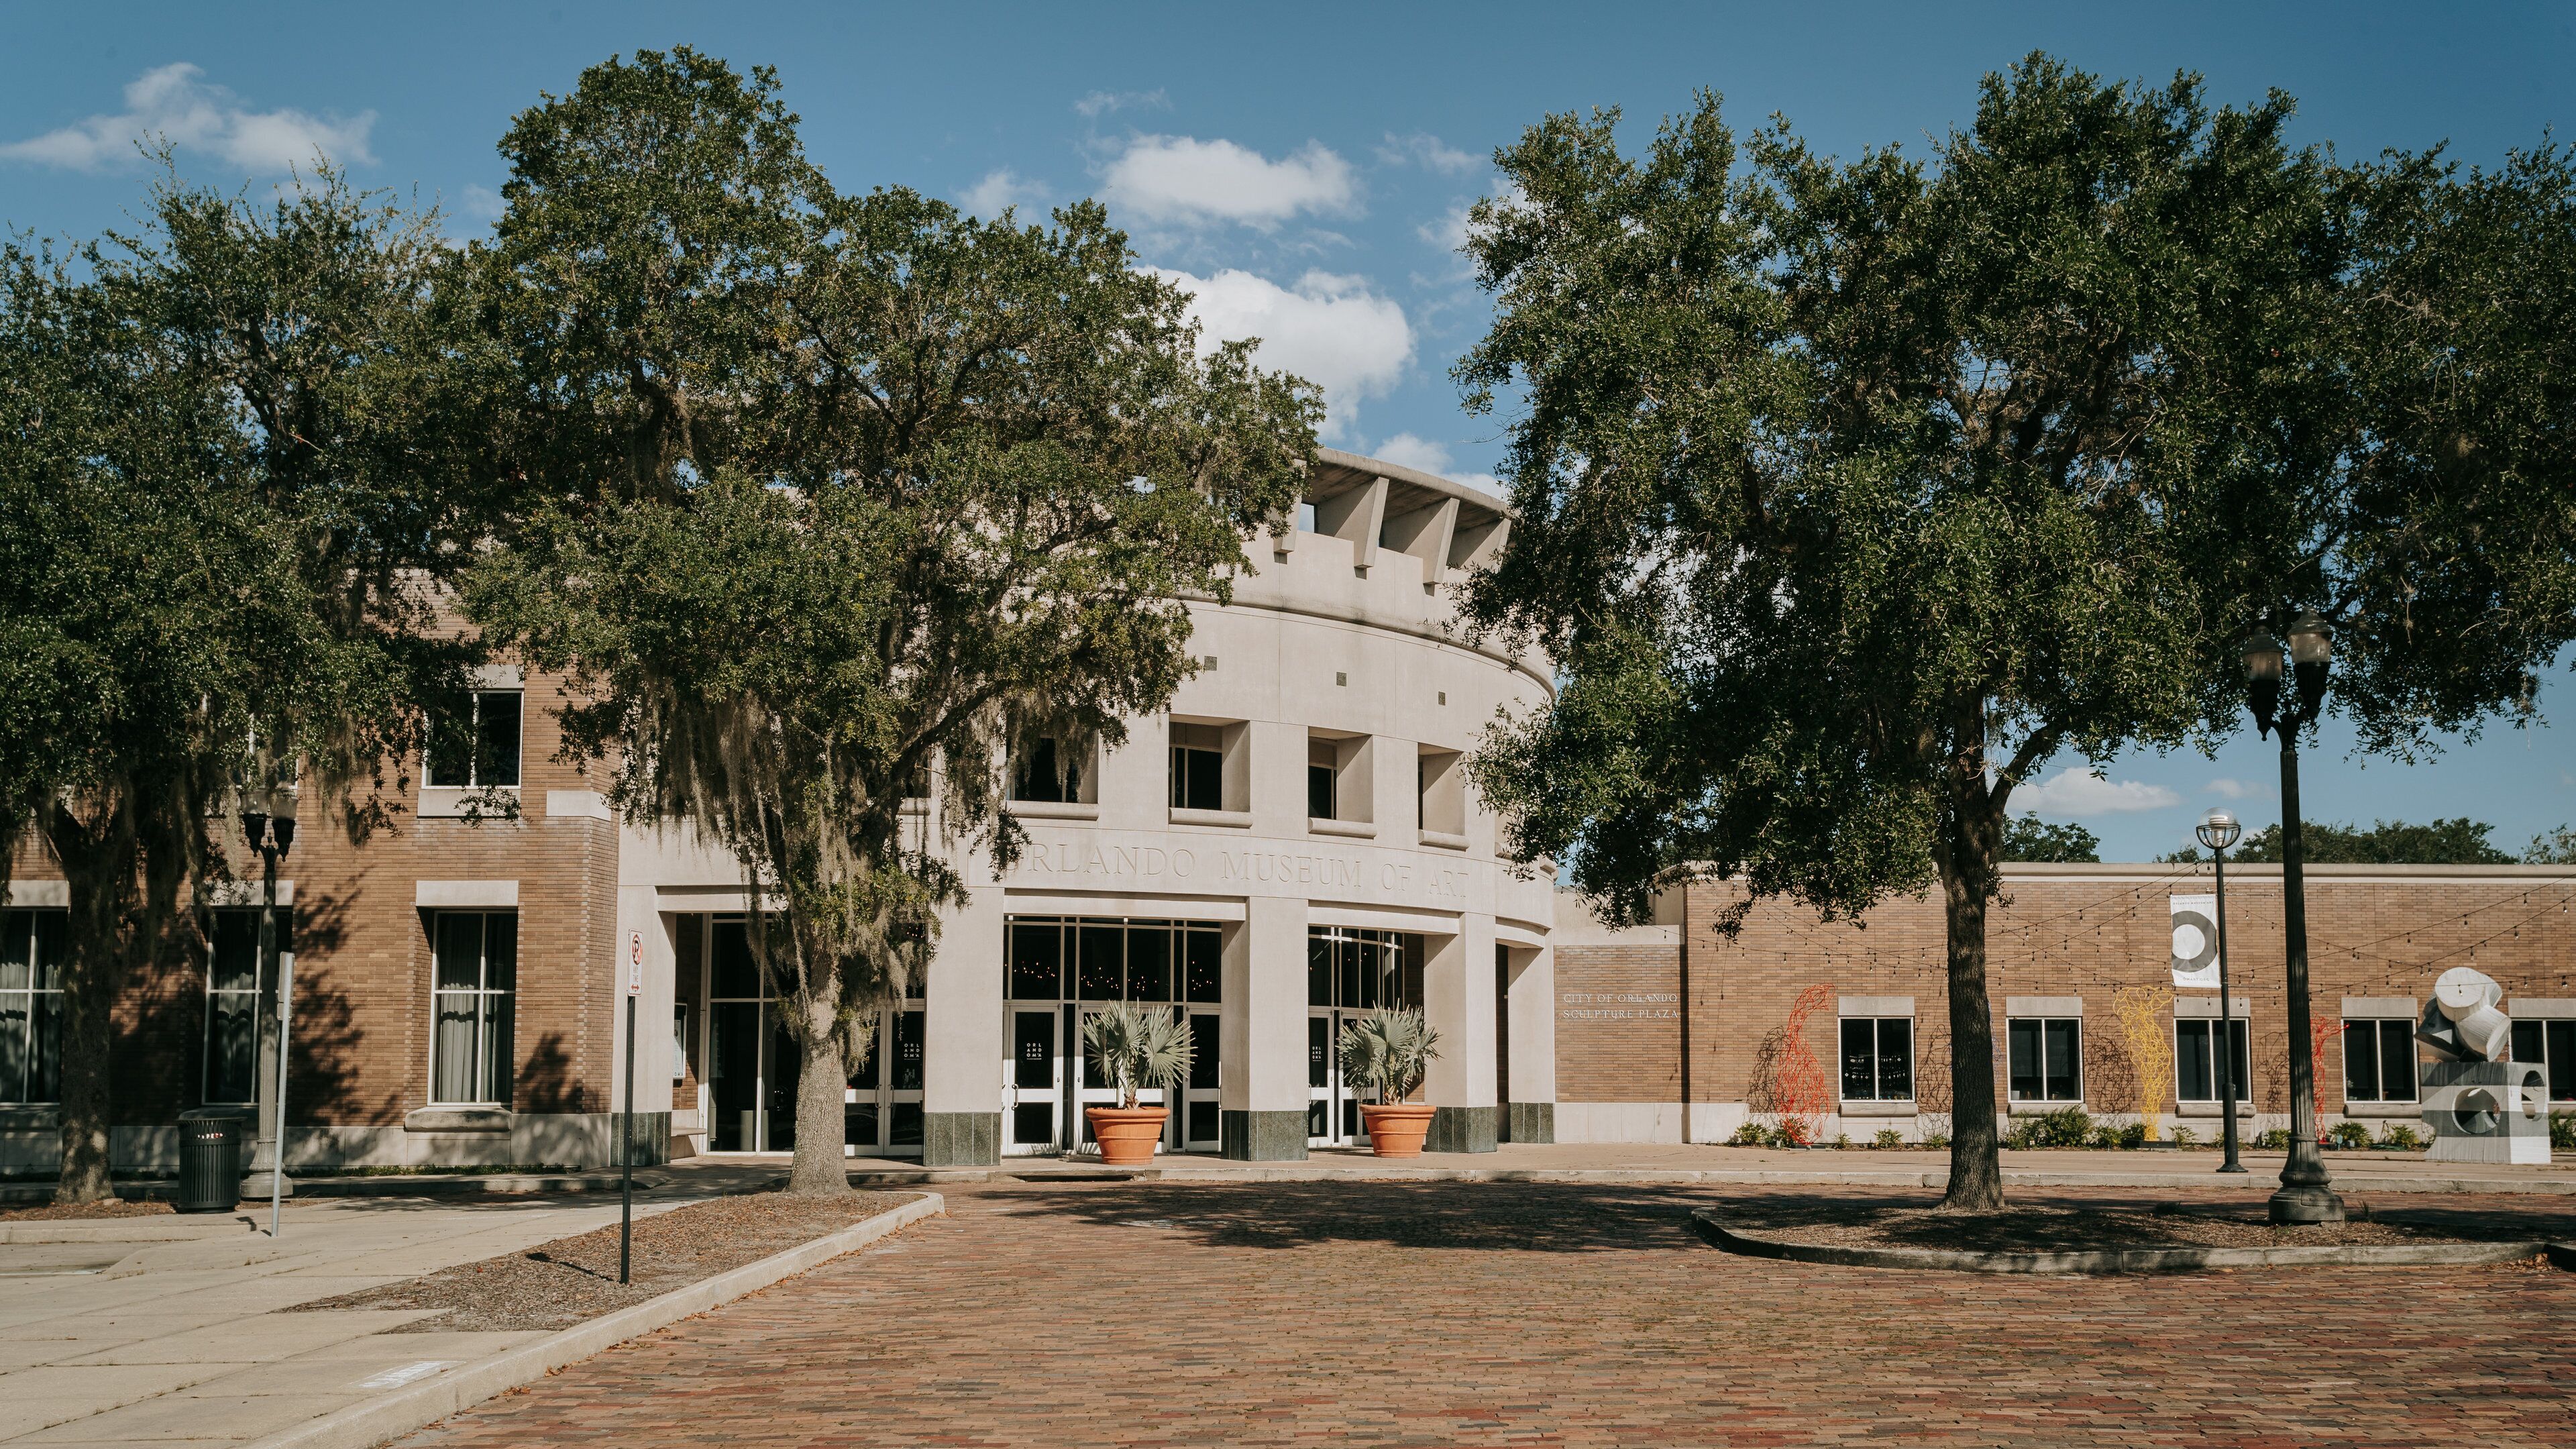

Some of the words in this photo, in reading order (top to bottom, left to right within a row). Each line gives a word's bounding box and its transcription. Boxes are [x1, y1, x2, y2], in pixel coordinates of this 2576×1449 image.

[1220, 851, 1362, 888] MUSEUM
[1381, 863, 1411, 892] OF
[1428, 870, 1469, 898] ART
[1564, 994, 1592, 1003] CITY
[1597, 994, 1613, 1003] OF
[1617, 994, 1678, 1003] ORLANDO
[1563, 1010, 1633, 1018] SCULPTURE
[1639, 1010, 1678, 1018] PLAZA
